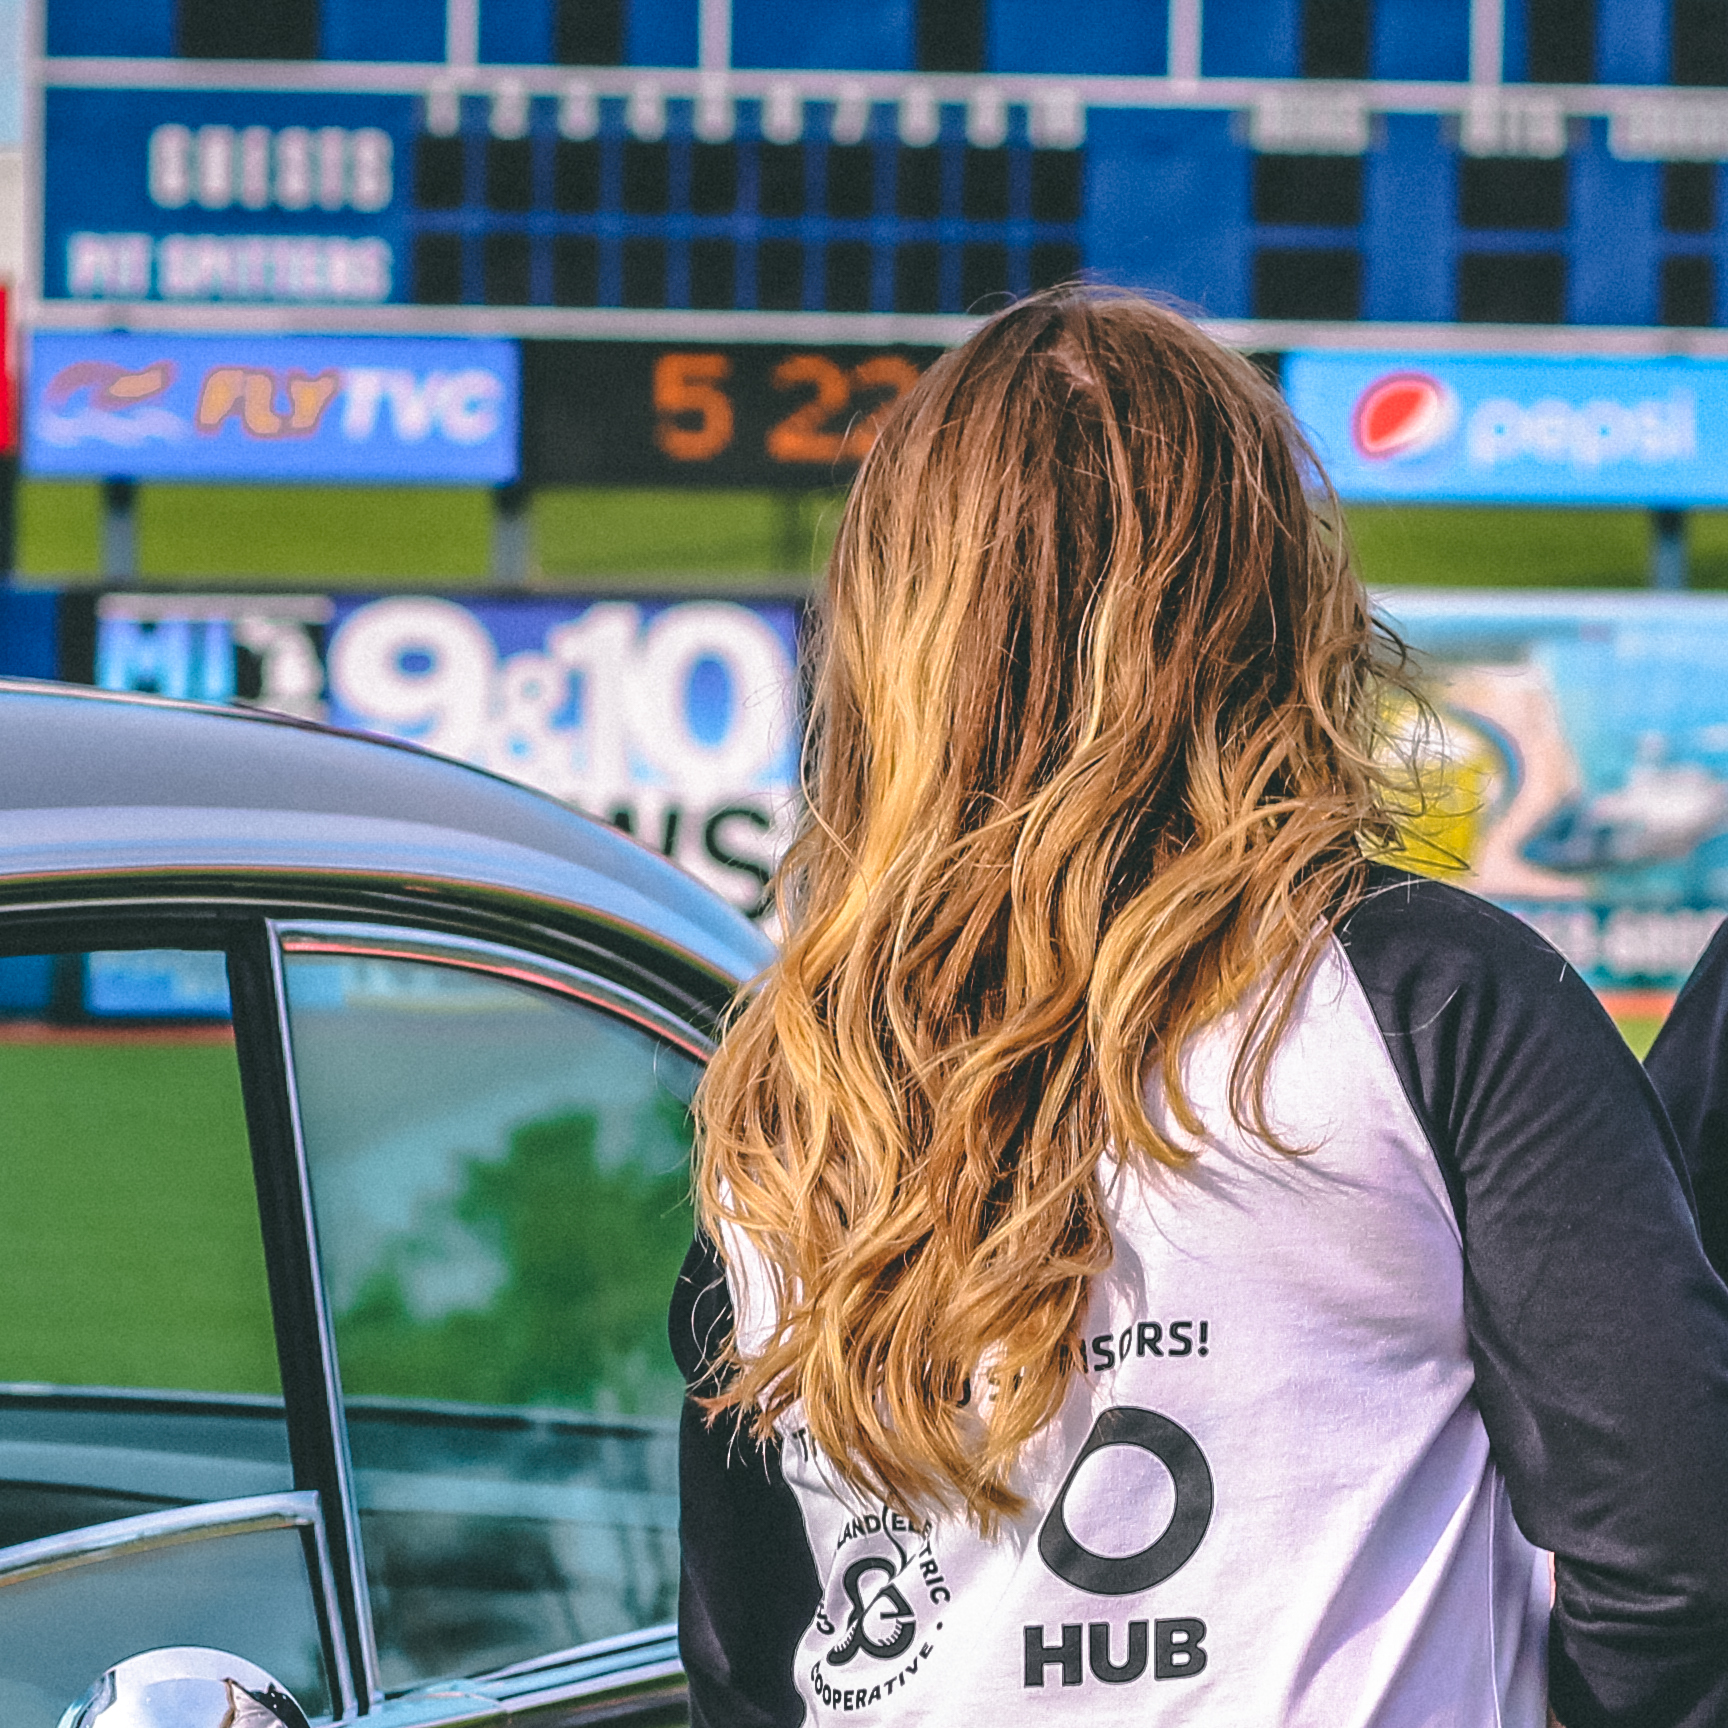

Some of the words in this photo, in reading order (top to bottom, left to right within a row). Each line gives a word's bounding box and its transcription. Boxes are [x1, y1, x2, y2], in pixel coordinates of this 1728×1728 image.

[654, 353, 733, 461] 5
[1468, 386, 1696, 468] pepsi
[810, 1642, 934, 1711] COOPERATIVE
[1024, 1617, 1208, 1688] HUB
